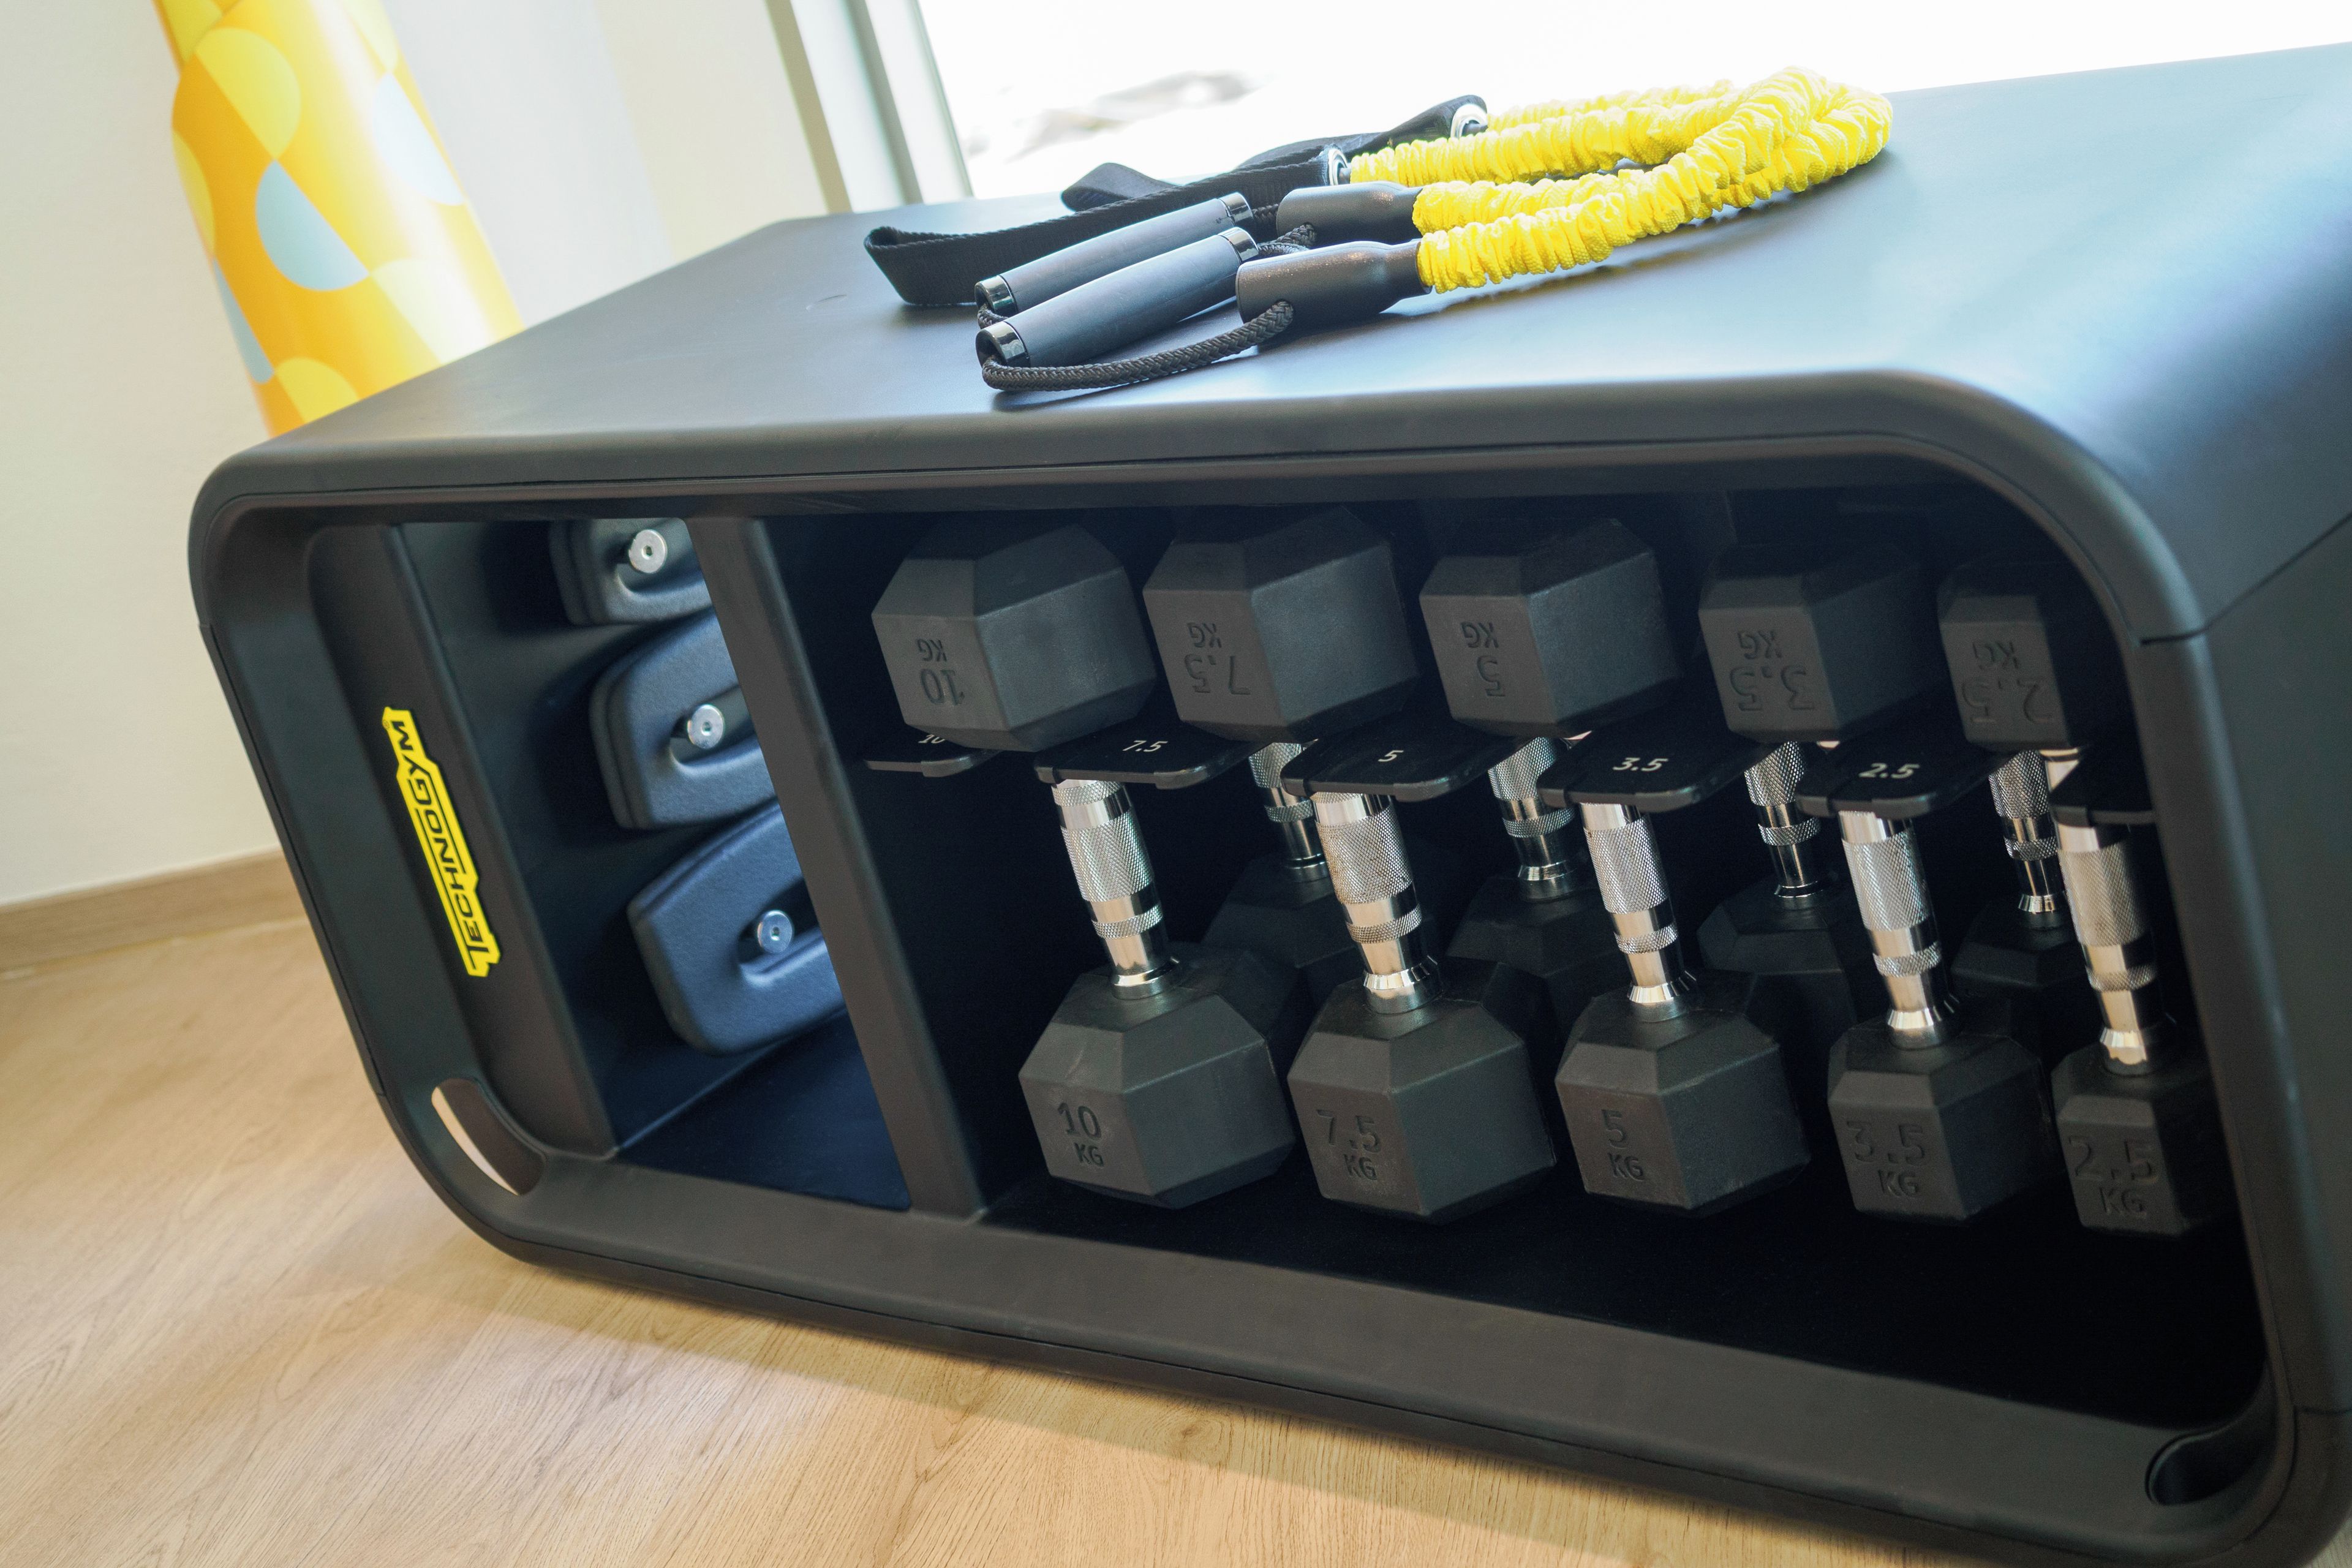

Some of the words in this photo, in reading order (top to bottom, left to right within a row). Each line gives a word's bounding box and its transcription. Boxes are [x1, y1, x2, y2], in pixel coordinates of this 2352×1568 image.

[916, 638, 947, 662] KG
[1186, 622, 1222, 648] KG
[1460, 621, 1499, 648] KG
[1737, 629, 1782, 660] KG
[920, 668, 965, 705] 10
[1184, 653, 1251, 695] 7.5
[1476, 655, 1506, 697] 5
[1729, 665, 1815, 711] 3.5
[1122, 740, 1169, 752] 7.5
[1378, 750, 1404, 762] 5
[1612, 757, 1669, 771] 3.5
[1858, 763, 1921, 778] 2.5
[391, 720, 491, 971] TECHNOGYM
[1057, 1102, 1101, 1138] 10
[1316, 1109, 1380, 1153] 7.5
[1601, 1109, 1627, 1149] 5
[1074, 1142, 1104, 1167] KG
[1846, 1120, 1924, 1163] 3.5
[1343, 1153, 1378, 1181] KG
[1607, 1152, 1645, 1182] KG
[2068, 1134, 2158, 1183] 2.5
[1877, 1169, 1920, 1196] KG
[2099, 1185, 2147, 1218] KG
